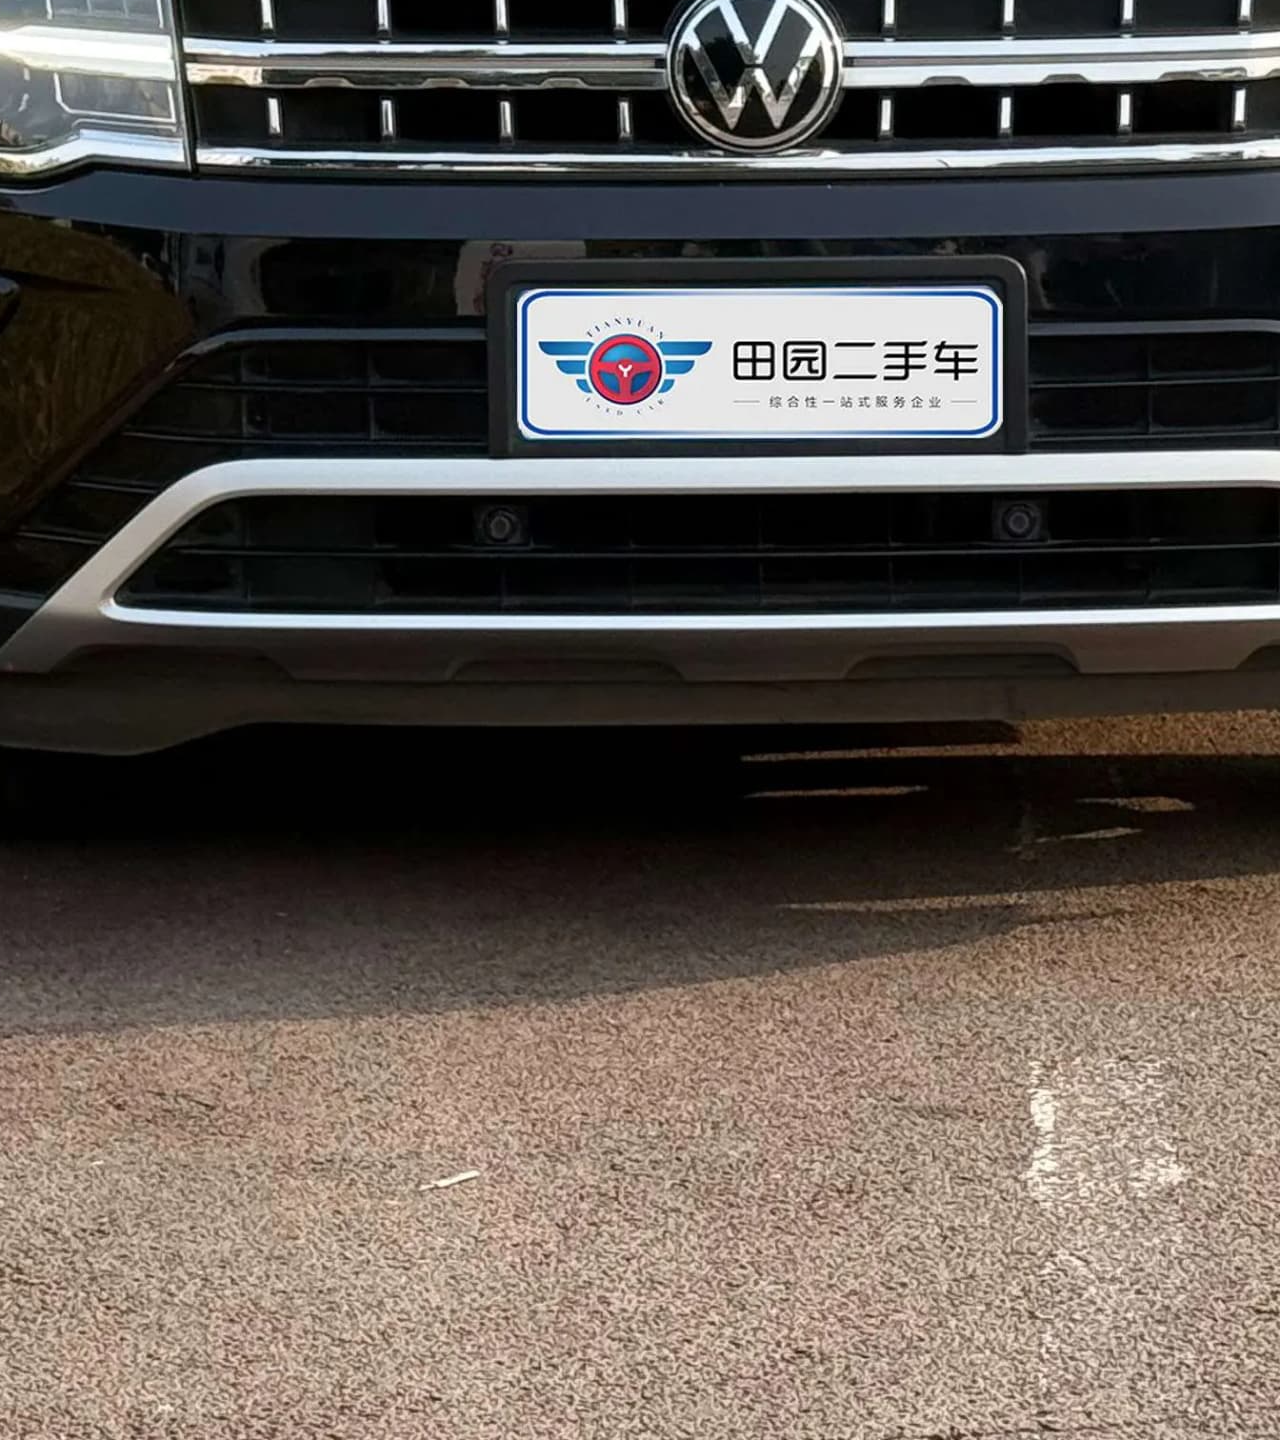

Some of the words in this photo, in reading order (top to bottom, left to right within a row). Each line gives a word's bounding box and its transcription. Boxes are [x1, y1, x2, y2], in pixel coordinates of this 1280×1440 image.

[732, 340, 979, 381] 田园二手车
[769, 395, 942, 409] 综合性一站式服务企业
